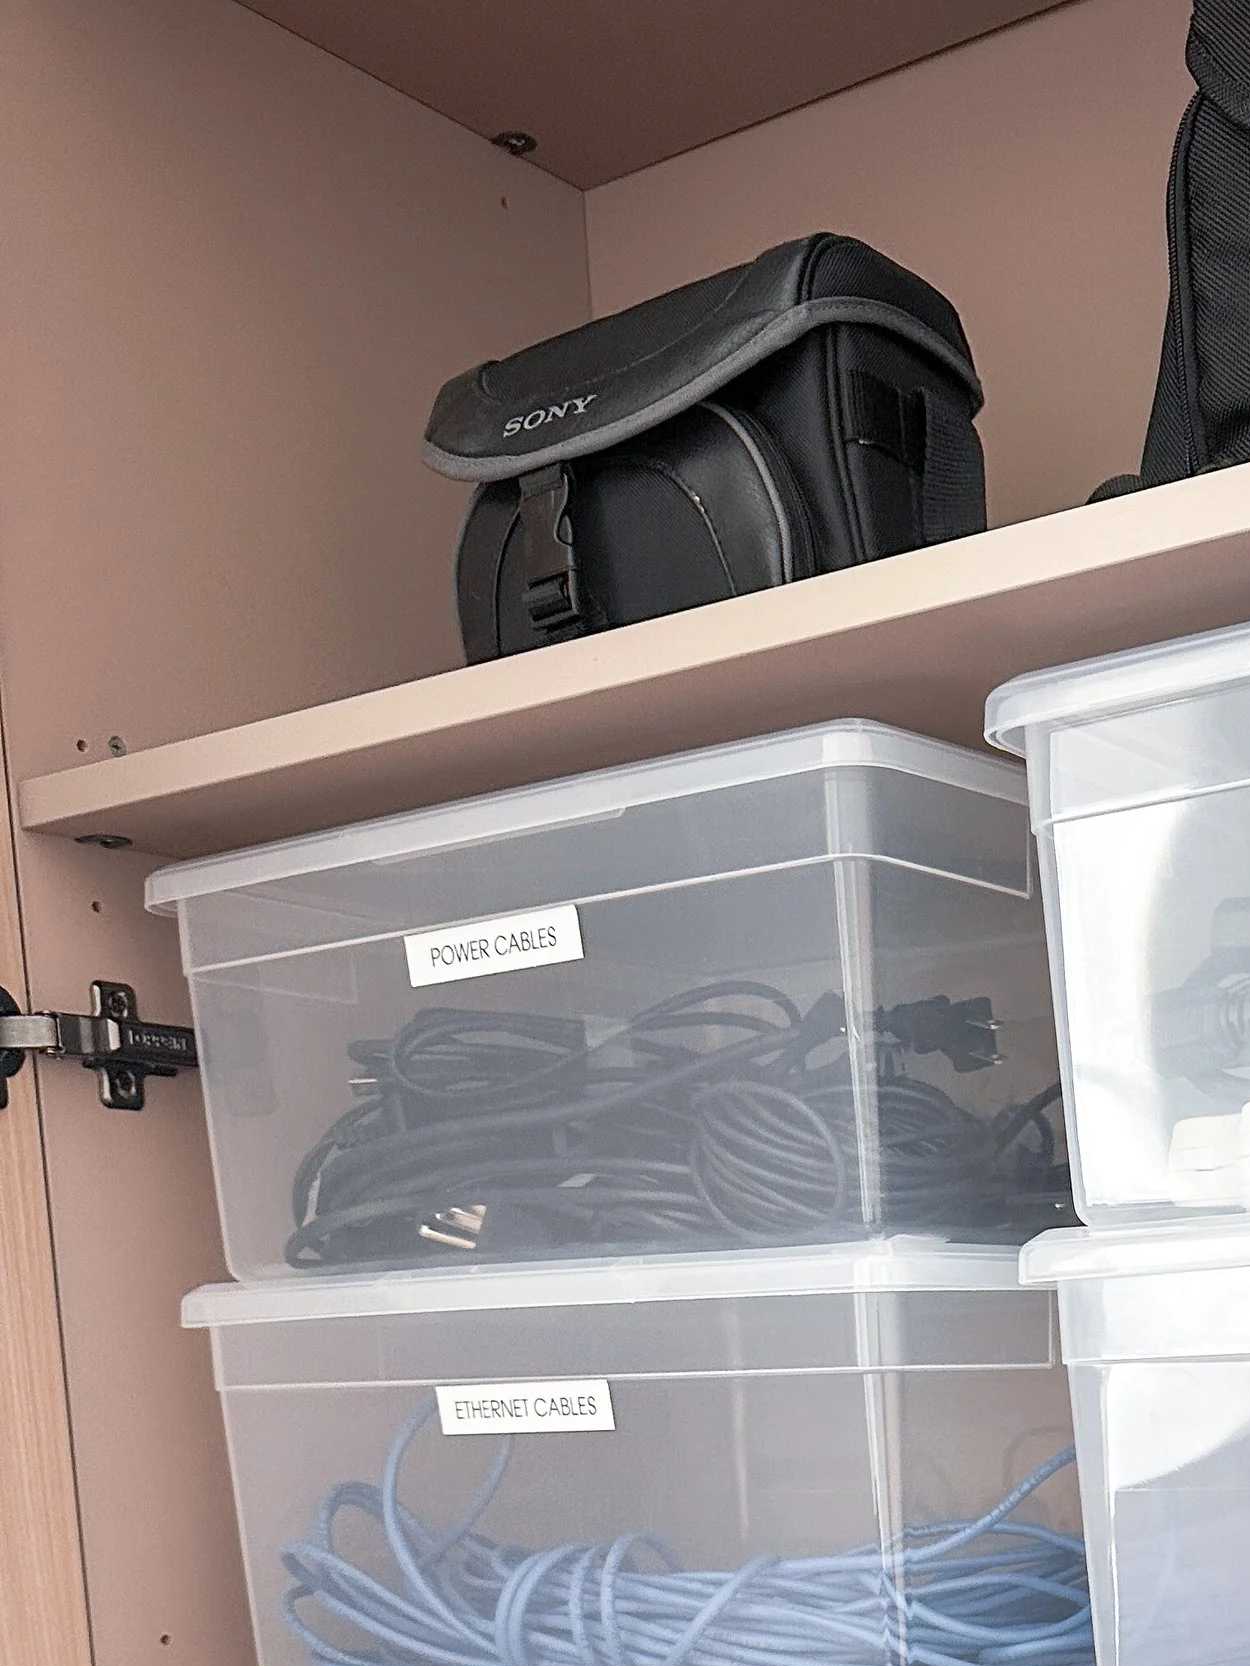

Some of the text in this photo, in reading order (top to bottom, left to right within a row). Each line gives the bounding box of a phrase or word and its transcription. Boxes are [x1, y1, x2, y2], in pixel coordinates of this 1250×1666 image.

[503, 394, 597, 438] SONY
[430, 925, 557, 967] POWER CABLES
[453, 1395, 597, 1420] ETHERNET CABLES
